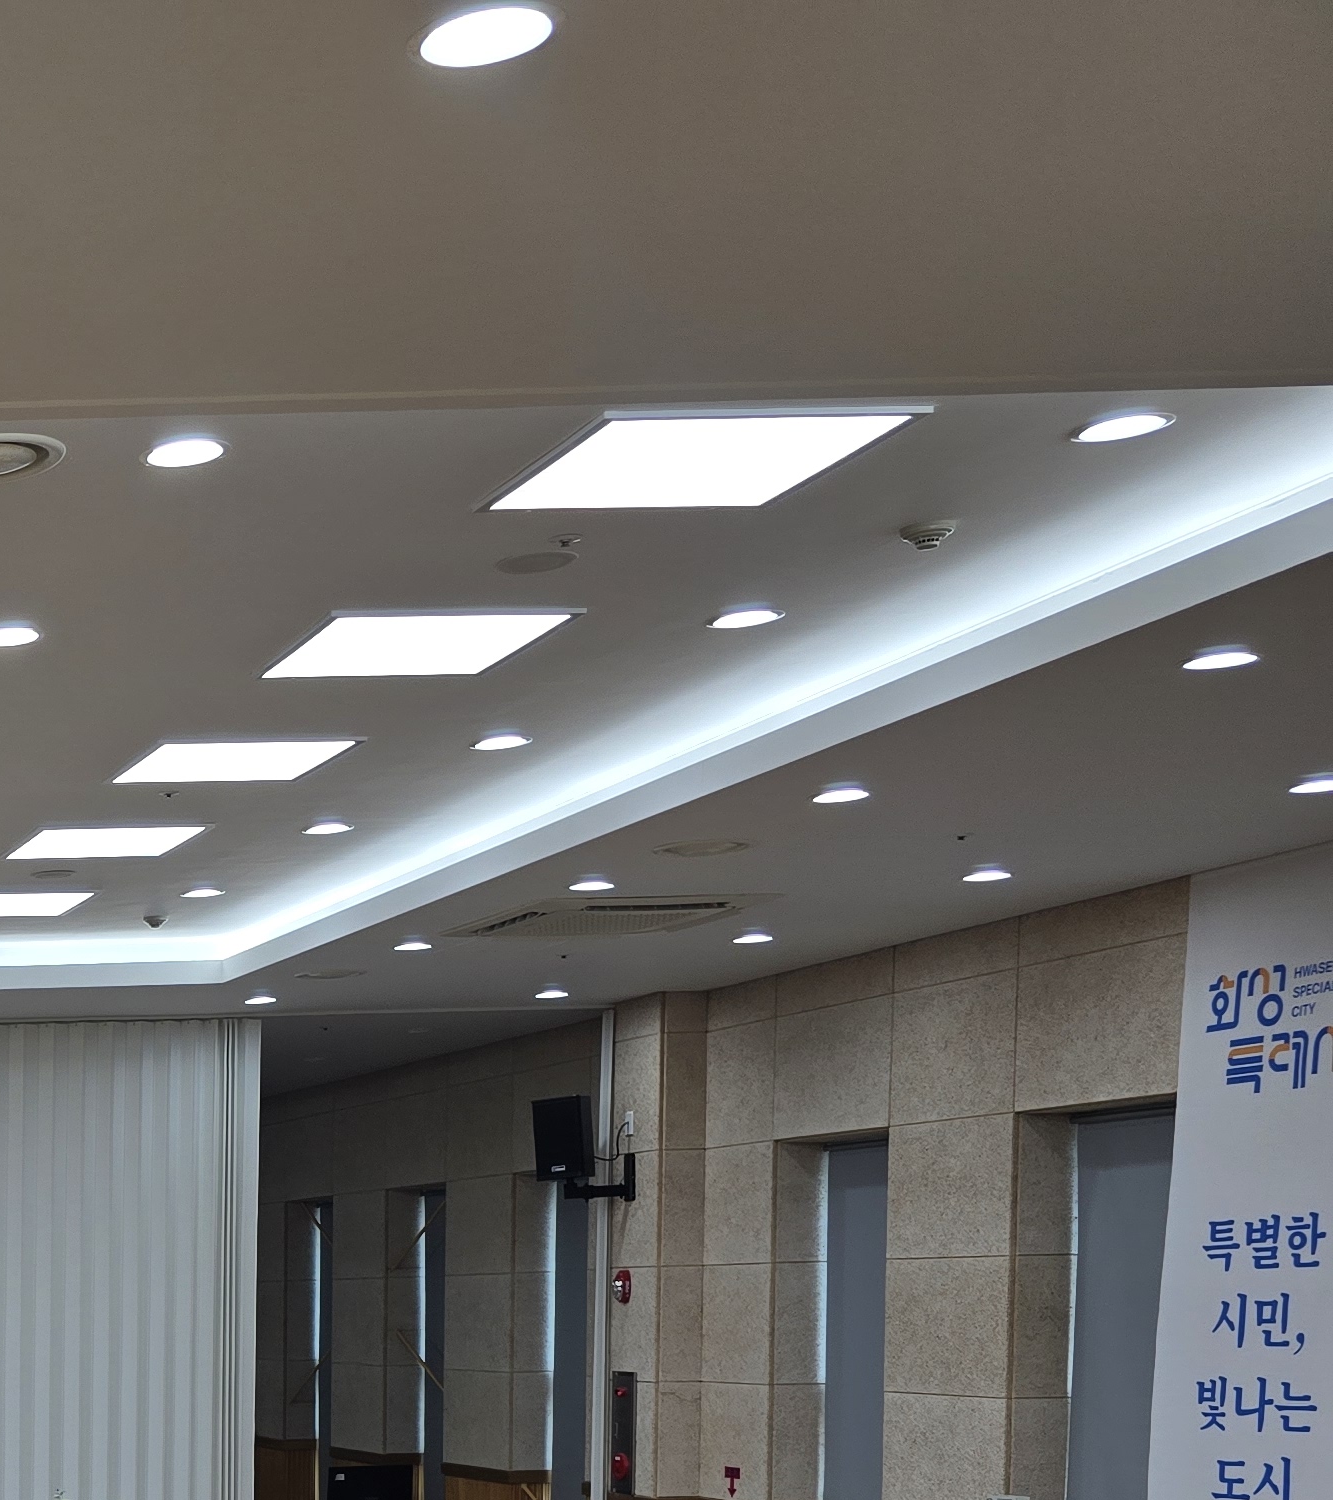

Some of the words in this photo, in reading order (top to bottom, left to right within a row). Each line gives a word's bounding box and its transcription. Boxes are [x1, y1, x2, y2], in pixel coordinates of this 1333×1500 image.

[1206, 964, 1286, 1033] 화성
[1291, 1002, 1316, 1017] CITY
[1201, 1212, 1326, 1272] 특별한
[1211, 1293, 1306, 1355] 시민,
[1196, 1376, 1318, 1433] 빛나는
